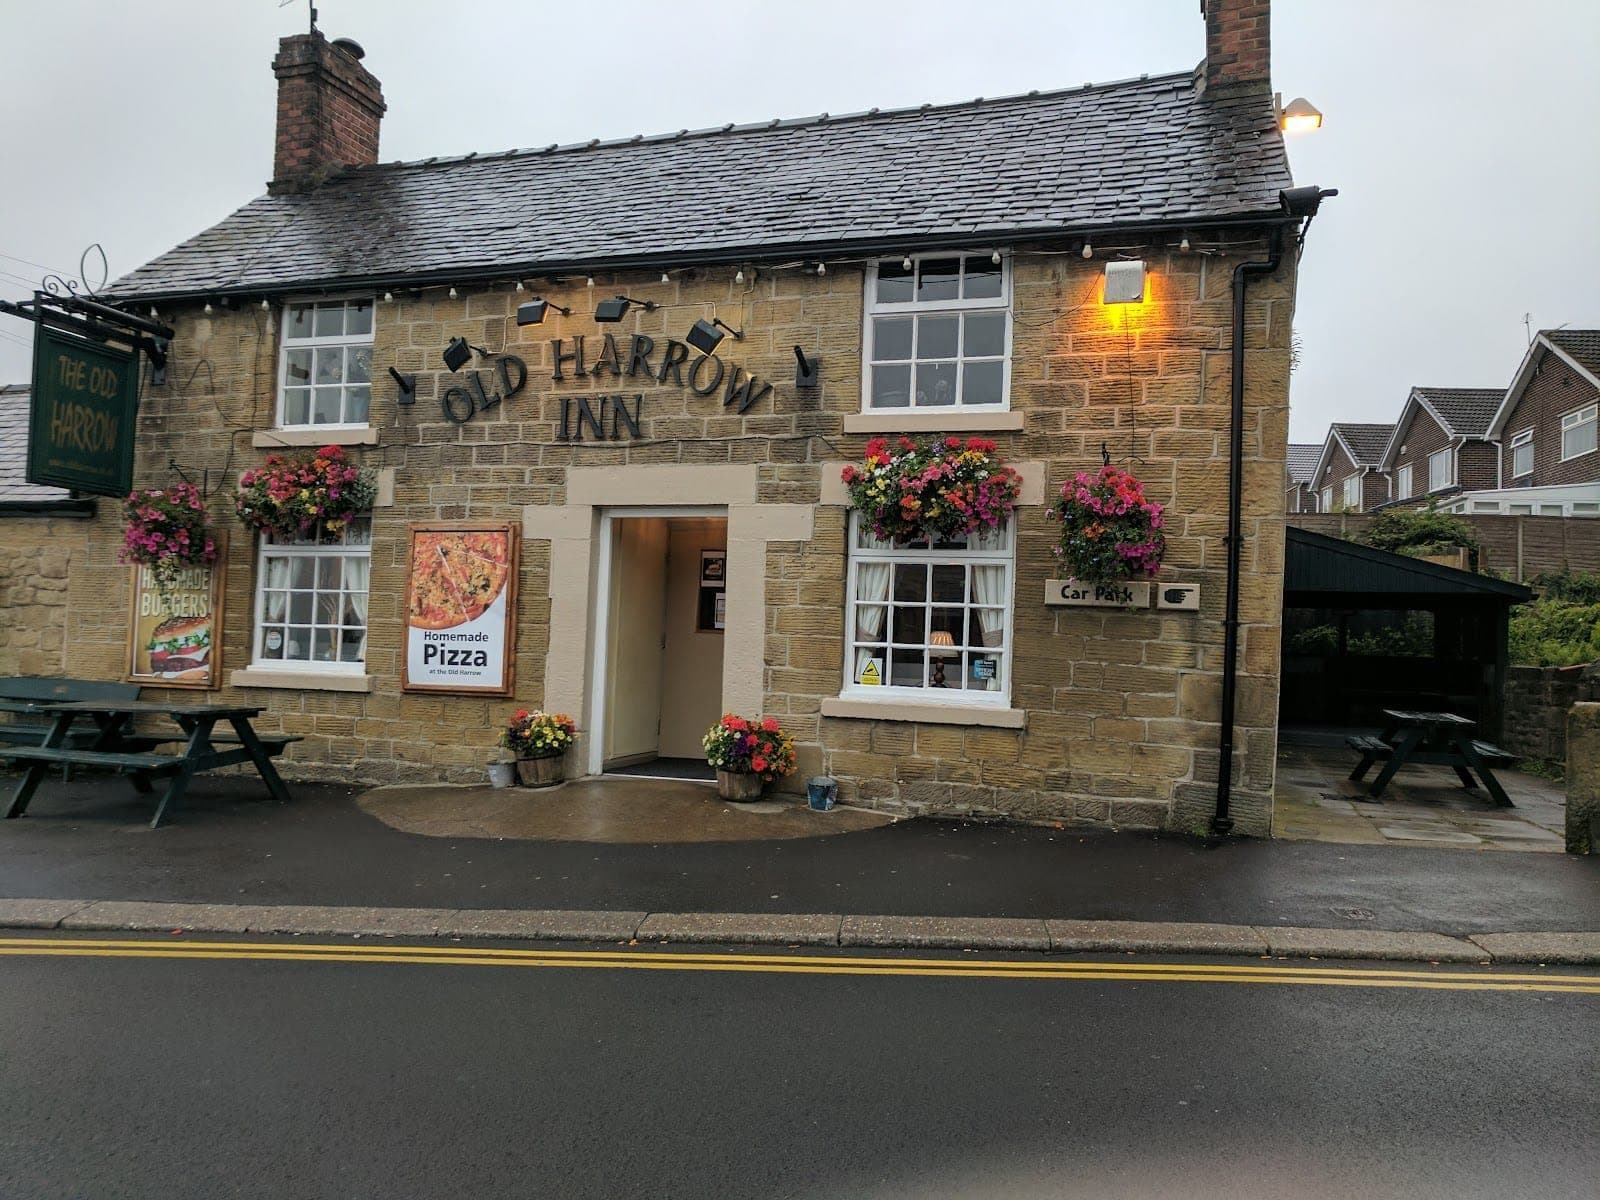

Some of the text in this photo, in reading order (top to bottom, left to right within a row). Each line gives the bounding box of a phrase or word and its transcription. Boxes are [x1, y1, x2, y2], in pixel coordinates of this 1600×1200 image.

[59, 355, 118, 399] THE OLD
[442, 333, 774, 424] OLD HARROW
[51, 401, 119, 451] HARROW
[558, 394, 643, 440] INN
[1061, 584, 1089, 600] Car
[424, 631, 489, 642] Homemade
[424, 643, 488, 667] Pizza
